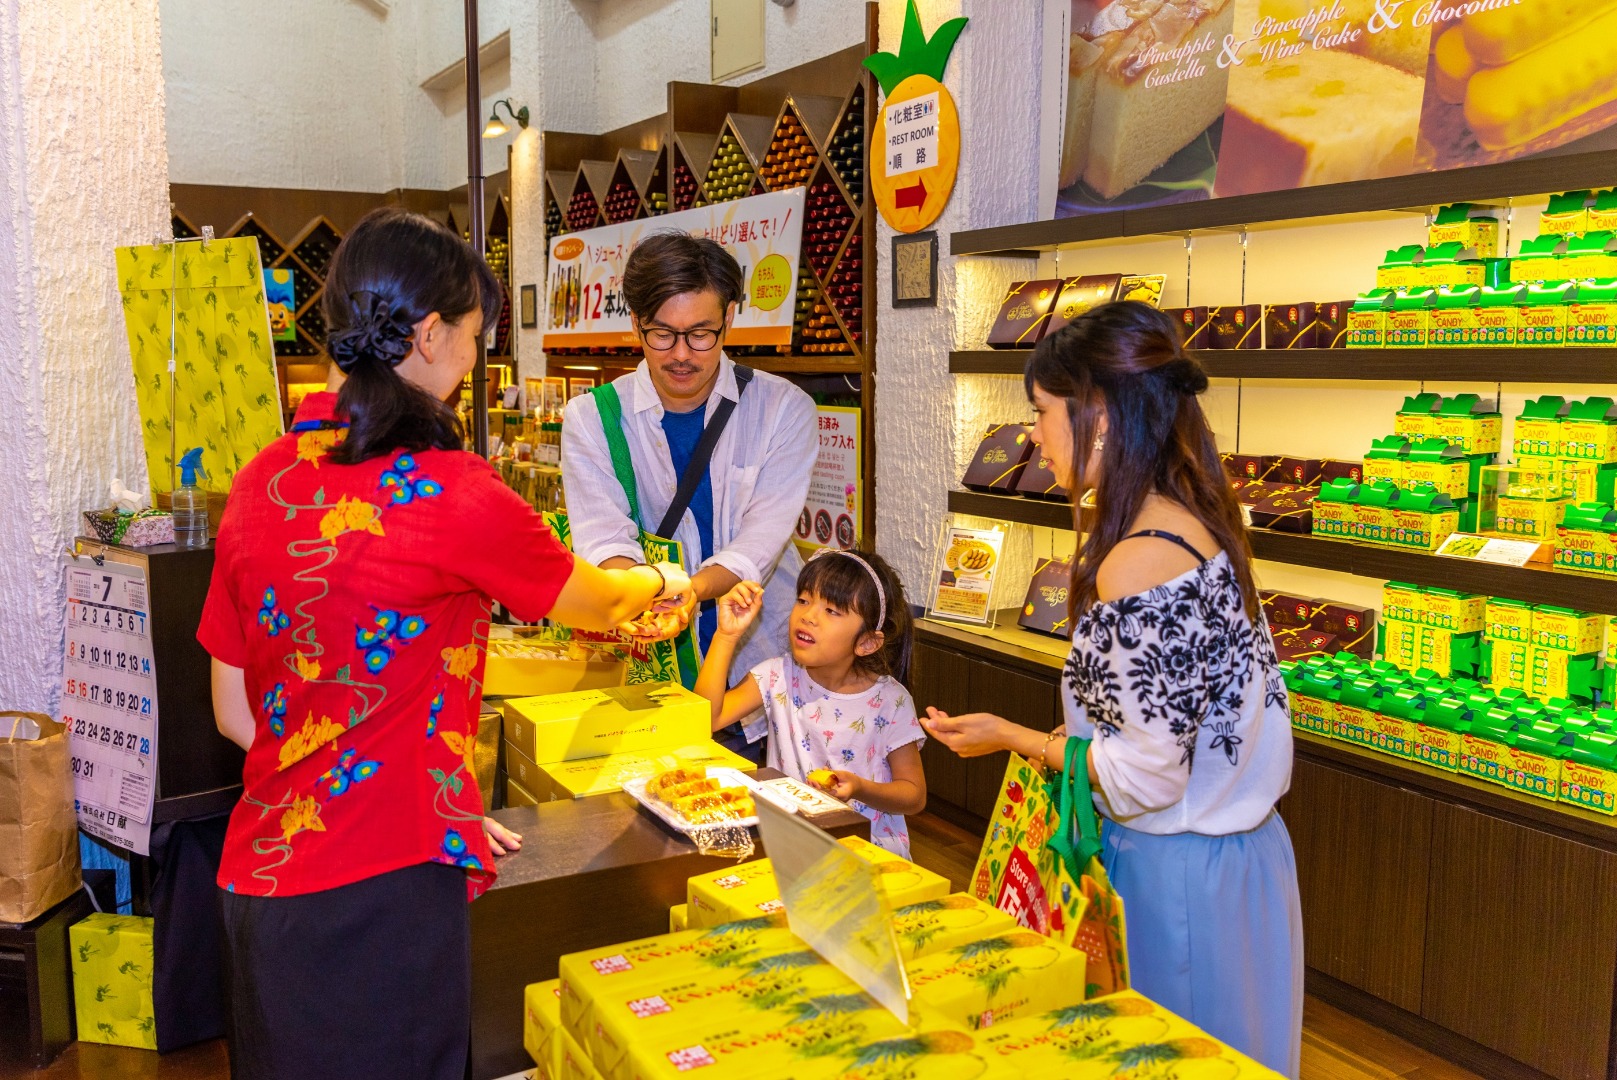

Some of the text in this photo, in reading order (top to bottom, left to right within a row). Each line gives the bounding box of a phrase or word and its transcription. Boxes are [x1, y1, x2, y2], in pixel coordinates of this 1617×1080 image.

[1249, 0, 1346, 41] Pineapple
[1367, 0, 1403, 33] &
[1259, 21, 1361, 62] Wine Cake
[1137, 31, 1216, 68] Pineapple
[1216, 33, 1247, 69] &
[1145, 58, 1206, 89] Castella
[893, 103, 923, 125] 化粧室
[892, 126, 934, 146] REST ROOM
[1547, 220, 1577, 232] CANDY
[1436, 231, 1461, 241] CANDY
[1353, 319, 1376, 329] CANDY
[1393, 319, 1418, 329] CANDY
[1436, 318, 1463, 327] CANDY
[1478, 316, 1508, 326] CANDY
[1525, 315, 1556, 326] CANDY
[1576, 313, 1608, 324] CANDY
[1401, 423, 1425, 432] CANDY
[1440, 425, 1465, 435] CANDY
[1522, 428, 1550, 439] CANDY
[1568, 430, 1597, 440] CANDY
[1369, 466, 1393, 476] CANDY
[1409, 469, 1435, 480] CANDY
[1319, 508, 1343, 519] CANDY
[1357, 512, 1382, 524] CANDY
[1505, 506, 1537, 518] CANDY
[1397, 518, 1424, 530] CANDY
[1563, 538, 1595, 550] CANDY
[102, 575, 113, 602] 7
[1389, 595, 1413, 606] CANDY
[1427, 602, 1452, 613] CANDY
[82, 606, 87, 621] 2
[93, 608, 98, 623] 3
[104, 611, 110, 626] 4
[117, 612, 123, 628] 5
[128, 615, 134, 631] 6
[139, 617, 144, 634] 7
[1493, 613, 1521, 625] CANDY
[1540, 620, 1569, 633] CANDY
[70, 641, 150, 674] 8 9 10 11 12 13 14
[67, 679, 151, 714] 15 16 17 18 19 20 21
[1300, 702, 1324, 716] CANDY
[1339, 712, 1364, 726] CANDY
[1379, 722, 1405, 738] CANDY
[75, 719, 86, 735] 23
[87, 722, 98, 739] 24
[100, 726, 111, 743] 25
[113, 729, 124, 747] 26
[126, 733, 138, 750] 27
[140, 737, 150, 755] 28
[1422, 733, 1450, 749] CANDY
[1469, 744, 1499, 761] CANDY
[71, 756, 81, 773] 30
[83, 760, 94, 778] 31
[1516, 758, 1548, 776] CANDY
[1571, 771, 1606, 789] CANDY
[1010, 857, 1029, 888] Store
